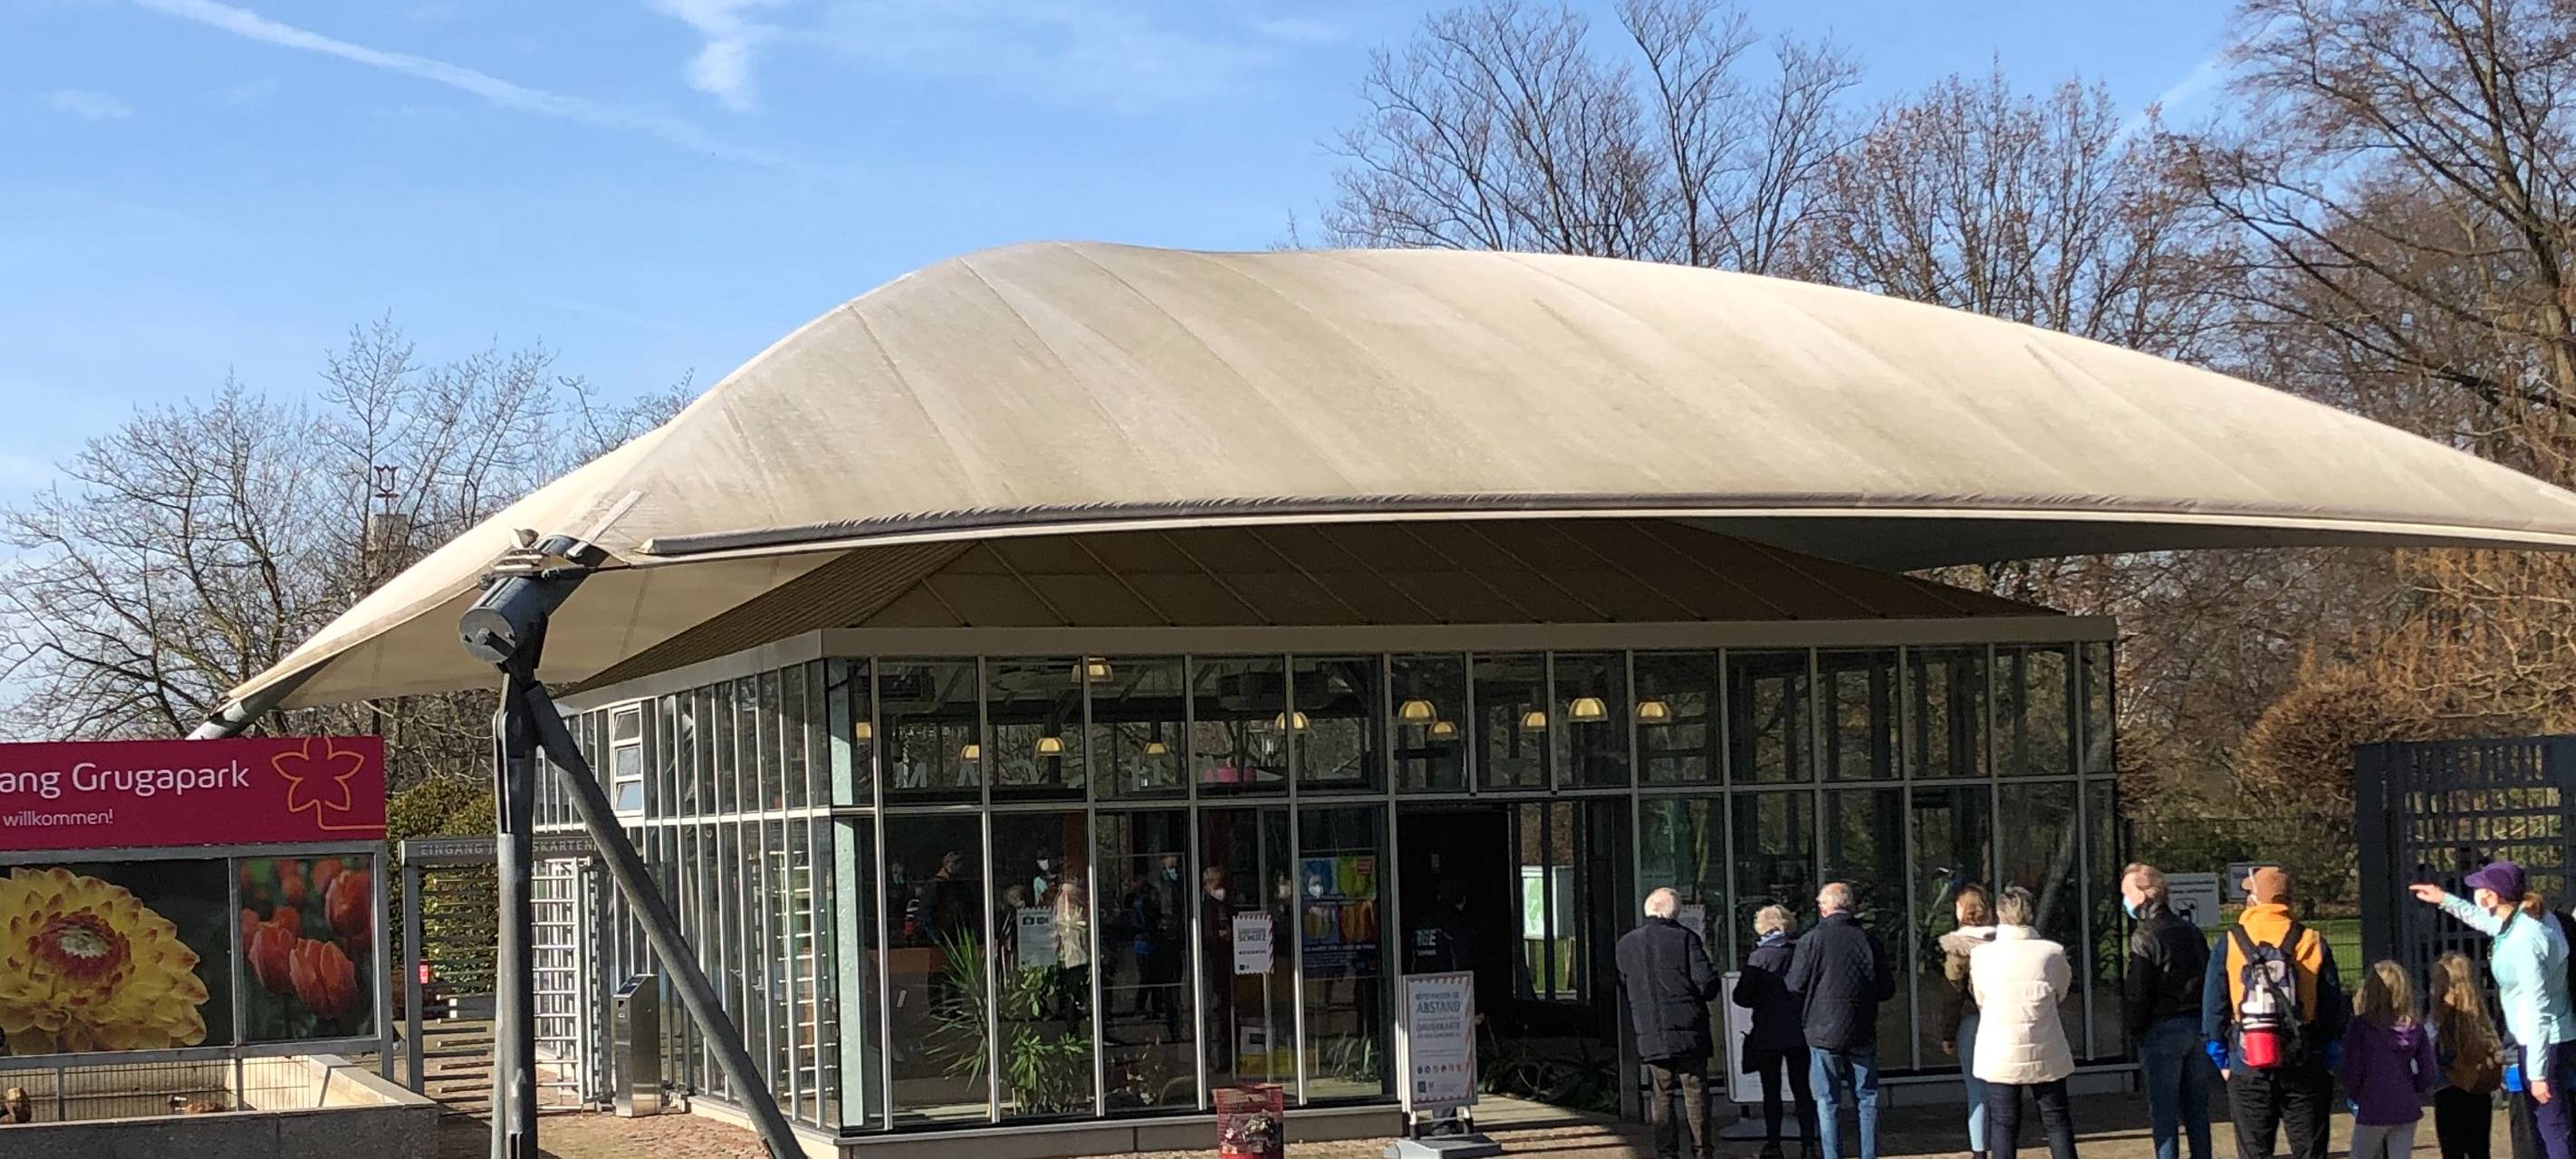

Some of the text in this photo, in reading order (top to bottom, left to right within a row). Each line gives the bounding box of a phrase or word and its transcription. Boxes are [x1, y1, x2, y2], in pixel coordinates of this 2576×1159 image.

[0, 759, 250, 799] ang Grugapark
[3, 809, 114, 827] willkommen!
[420, 843, 483, 856] EINGANG
[1416, 1000, 1461, 1014] ABSTAND
